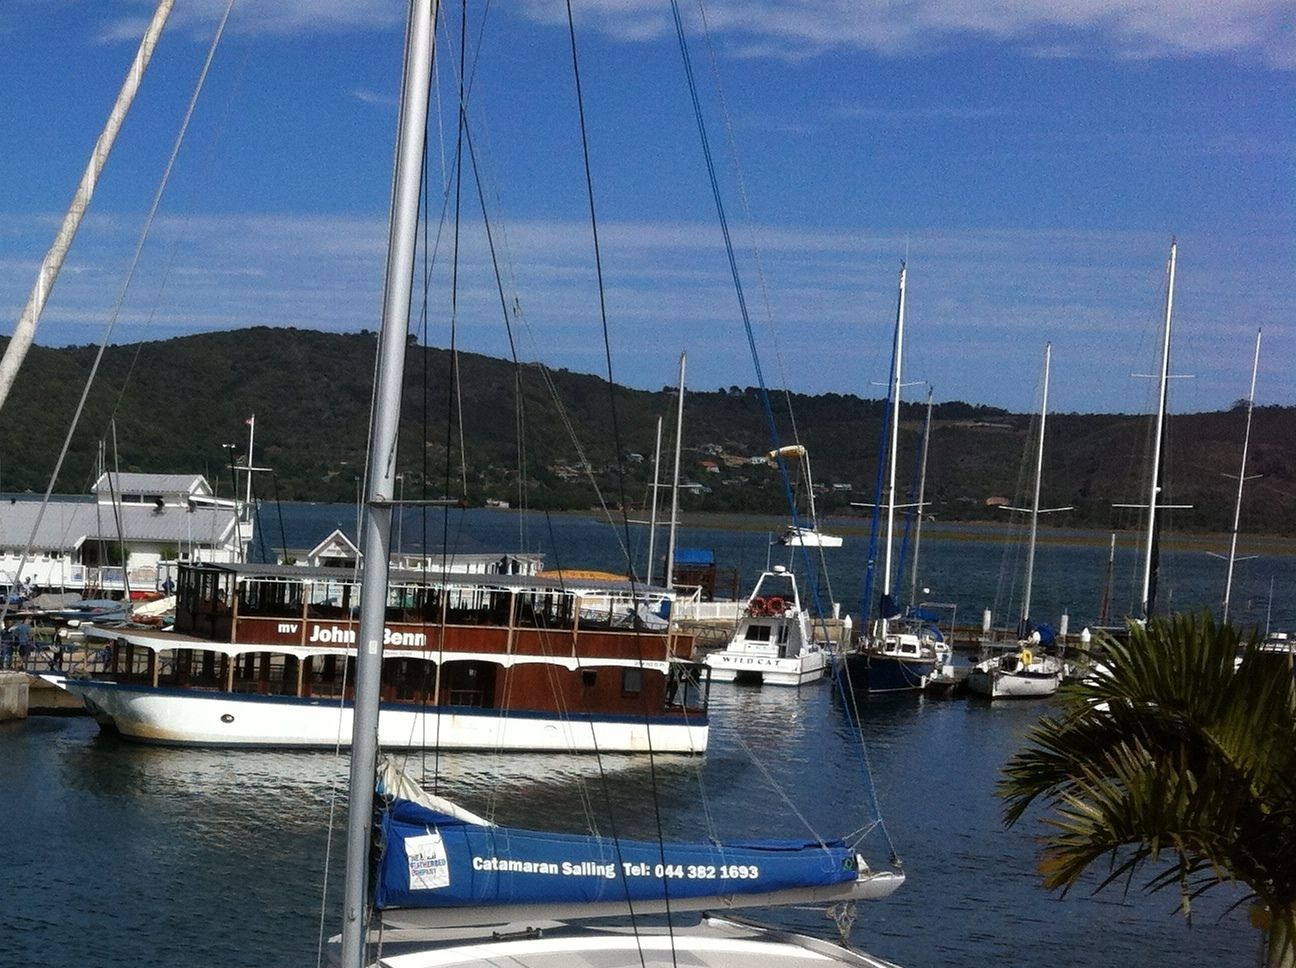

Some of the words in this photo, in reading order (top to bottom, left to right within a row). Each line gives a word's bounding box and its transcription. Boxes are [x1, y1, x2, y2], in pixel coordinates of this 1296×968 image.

[277, 622, 298, 634] mv
[309, 625, 356, 644] John
[383, 628, 427, 647] Benn
[472, 856, 559, 875] Catamaran
[561, 861, 616, 879] Sailing
[622, 862, 651, 876] Tel:
[654, 864, 684, 879] 044
[687, 865, 716, 879] 382
[719, 865, 759, 879] 1693
